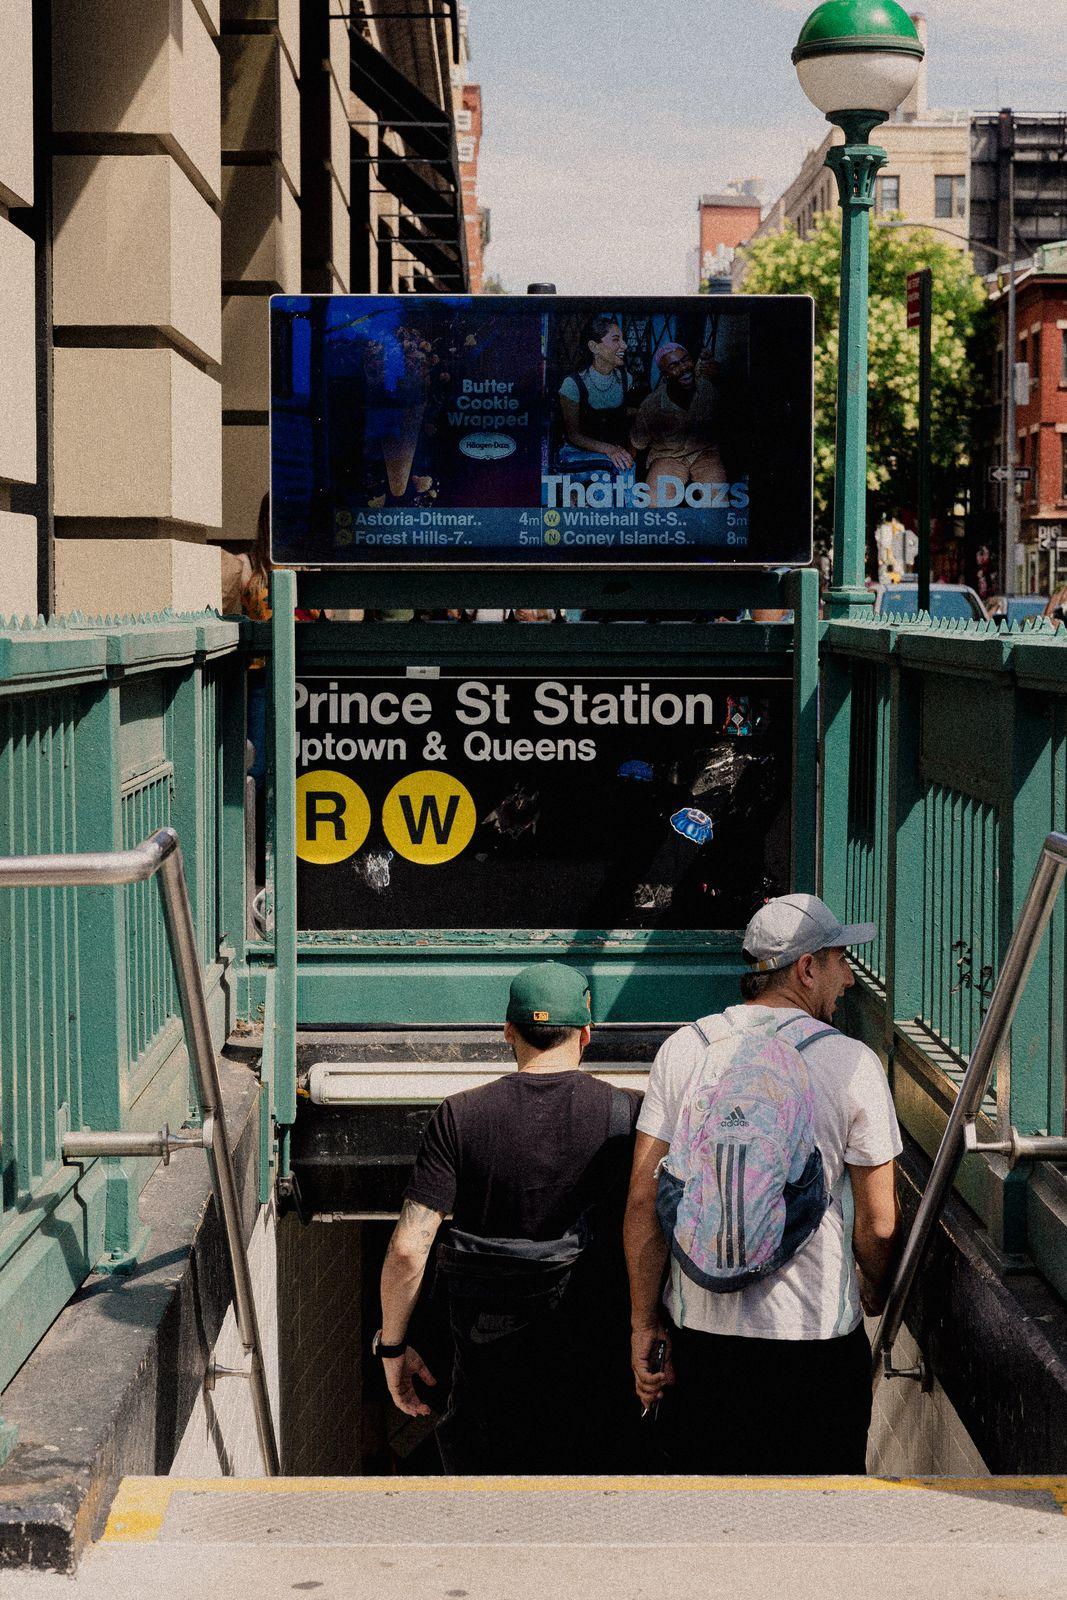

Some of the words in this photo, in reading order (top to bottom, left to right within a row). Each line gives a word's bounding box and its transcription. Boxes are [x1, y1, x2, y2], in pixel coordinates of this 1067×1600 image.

[462, 378, 515, 394] Butter
[456, 395, 520, 410] Cookie
[447, 412, 529, 429] Wrapped
[563, 511, 638, 526] Whitehall
[355, 531, 408, 545] Forest
[563, 530, 615, 546] Coney
[455, 681, 511, 725] St
[533, 681, 713, 725] Station
[295, 731, 407, 767] ptown
[422, 731, 448, 761] &
[463, 730, 597, 762] Queens
[305, 791, 348, 841] R
[398, 795, 461, 845] W
[720, 1118, 750, 1128] addas
